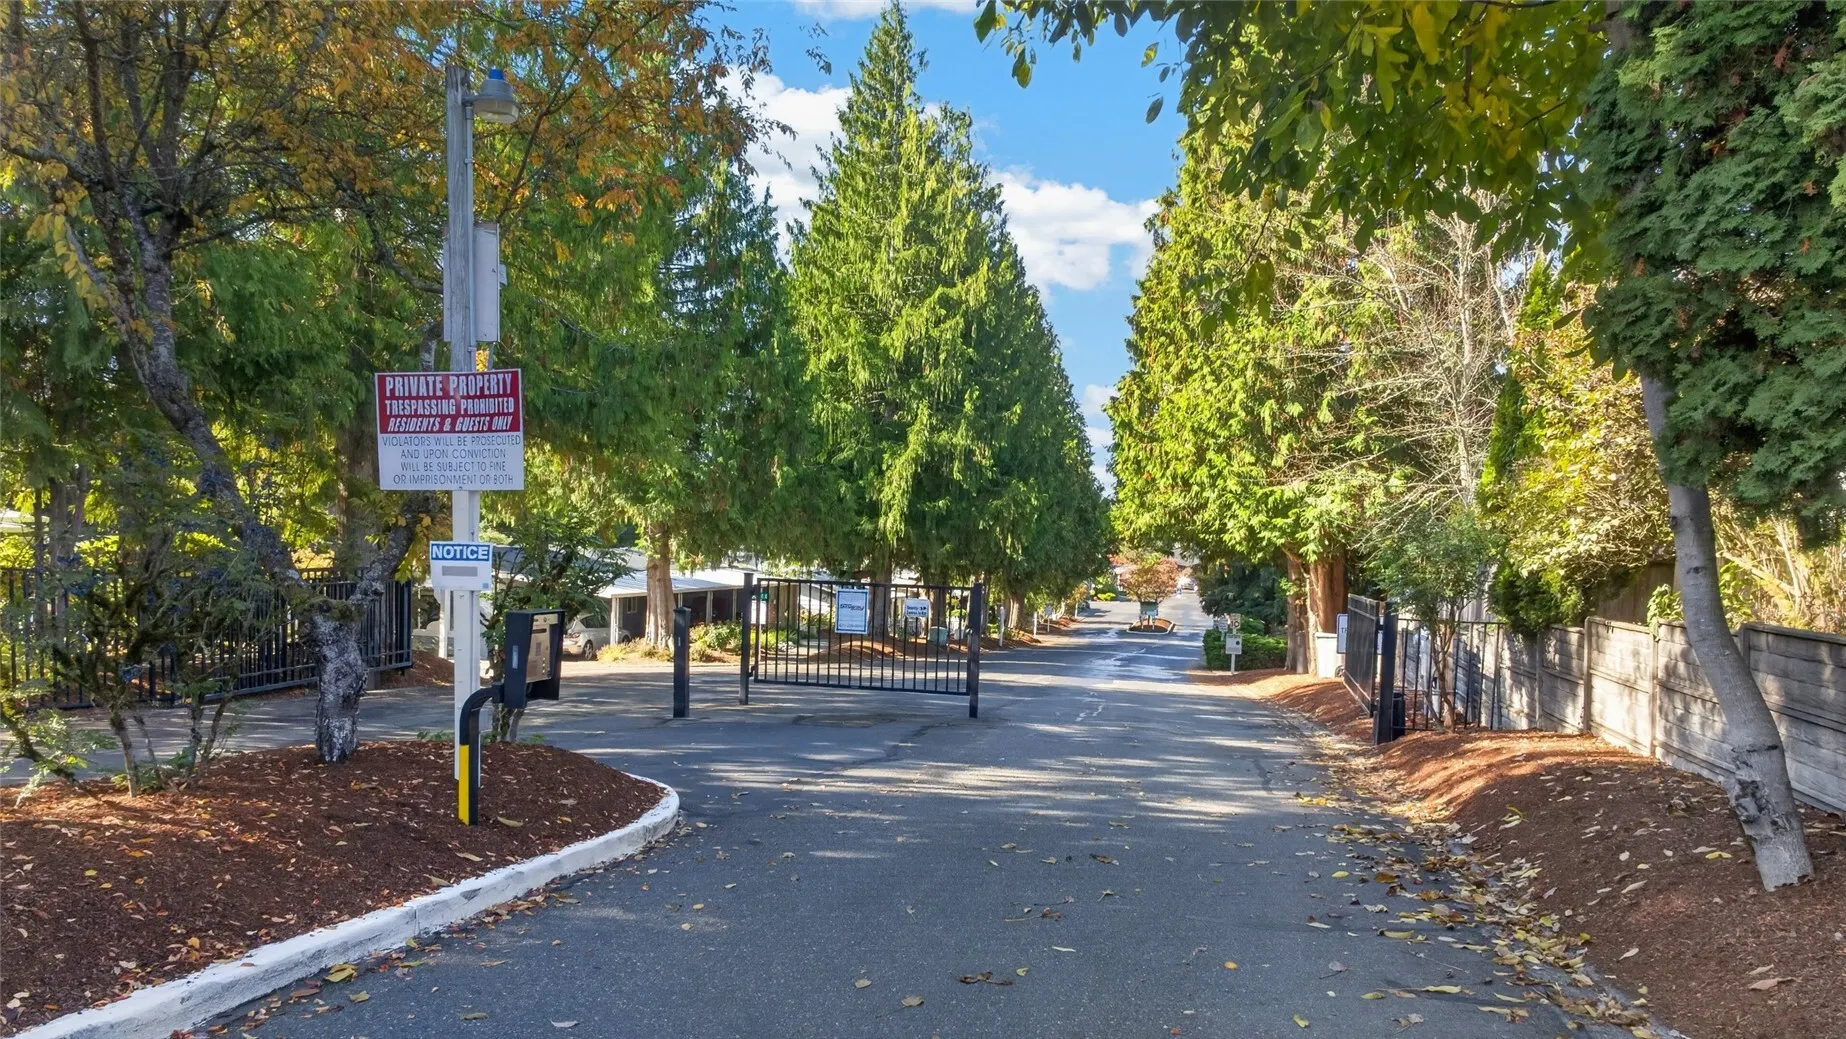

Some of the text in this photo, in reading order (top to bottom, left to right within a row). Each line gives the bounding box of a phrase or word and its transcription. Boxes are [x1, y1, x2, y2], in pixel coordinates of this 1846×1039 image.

[386, 373, 512, 396] PRIVATE PROPERTY
[385, 397, 514, 415] TRESPASSING PROHIBITED
[388, 415, 513, 432] RESIDENTS & GUESTS ONLY
[382, 435, 520, 447] VIOLATORS WILL BE PROSECUTED
[400, 448, 506, 459] AND UPON CONVICTION
[400, 461, 506, 471] WILL BE SUBJECT TO FINE
[393, 474, 513, 485] OR IMPRISONMENT OR BOTH
[432, 546, 488, 559] NOTICE
